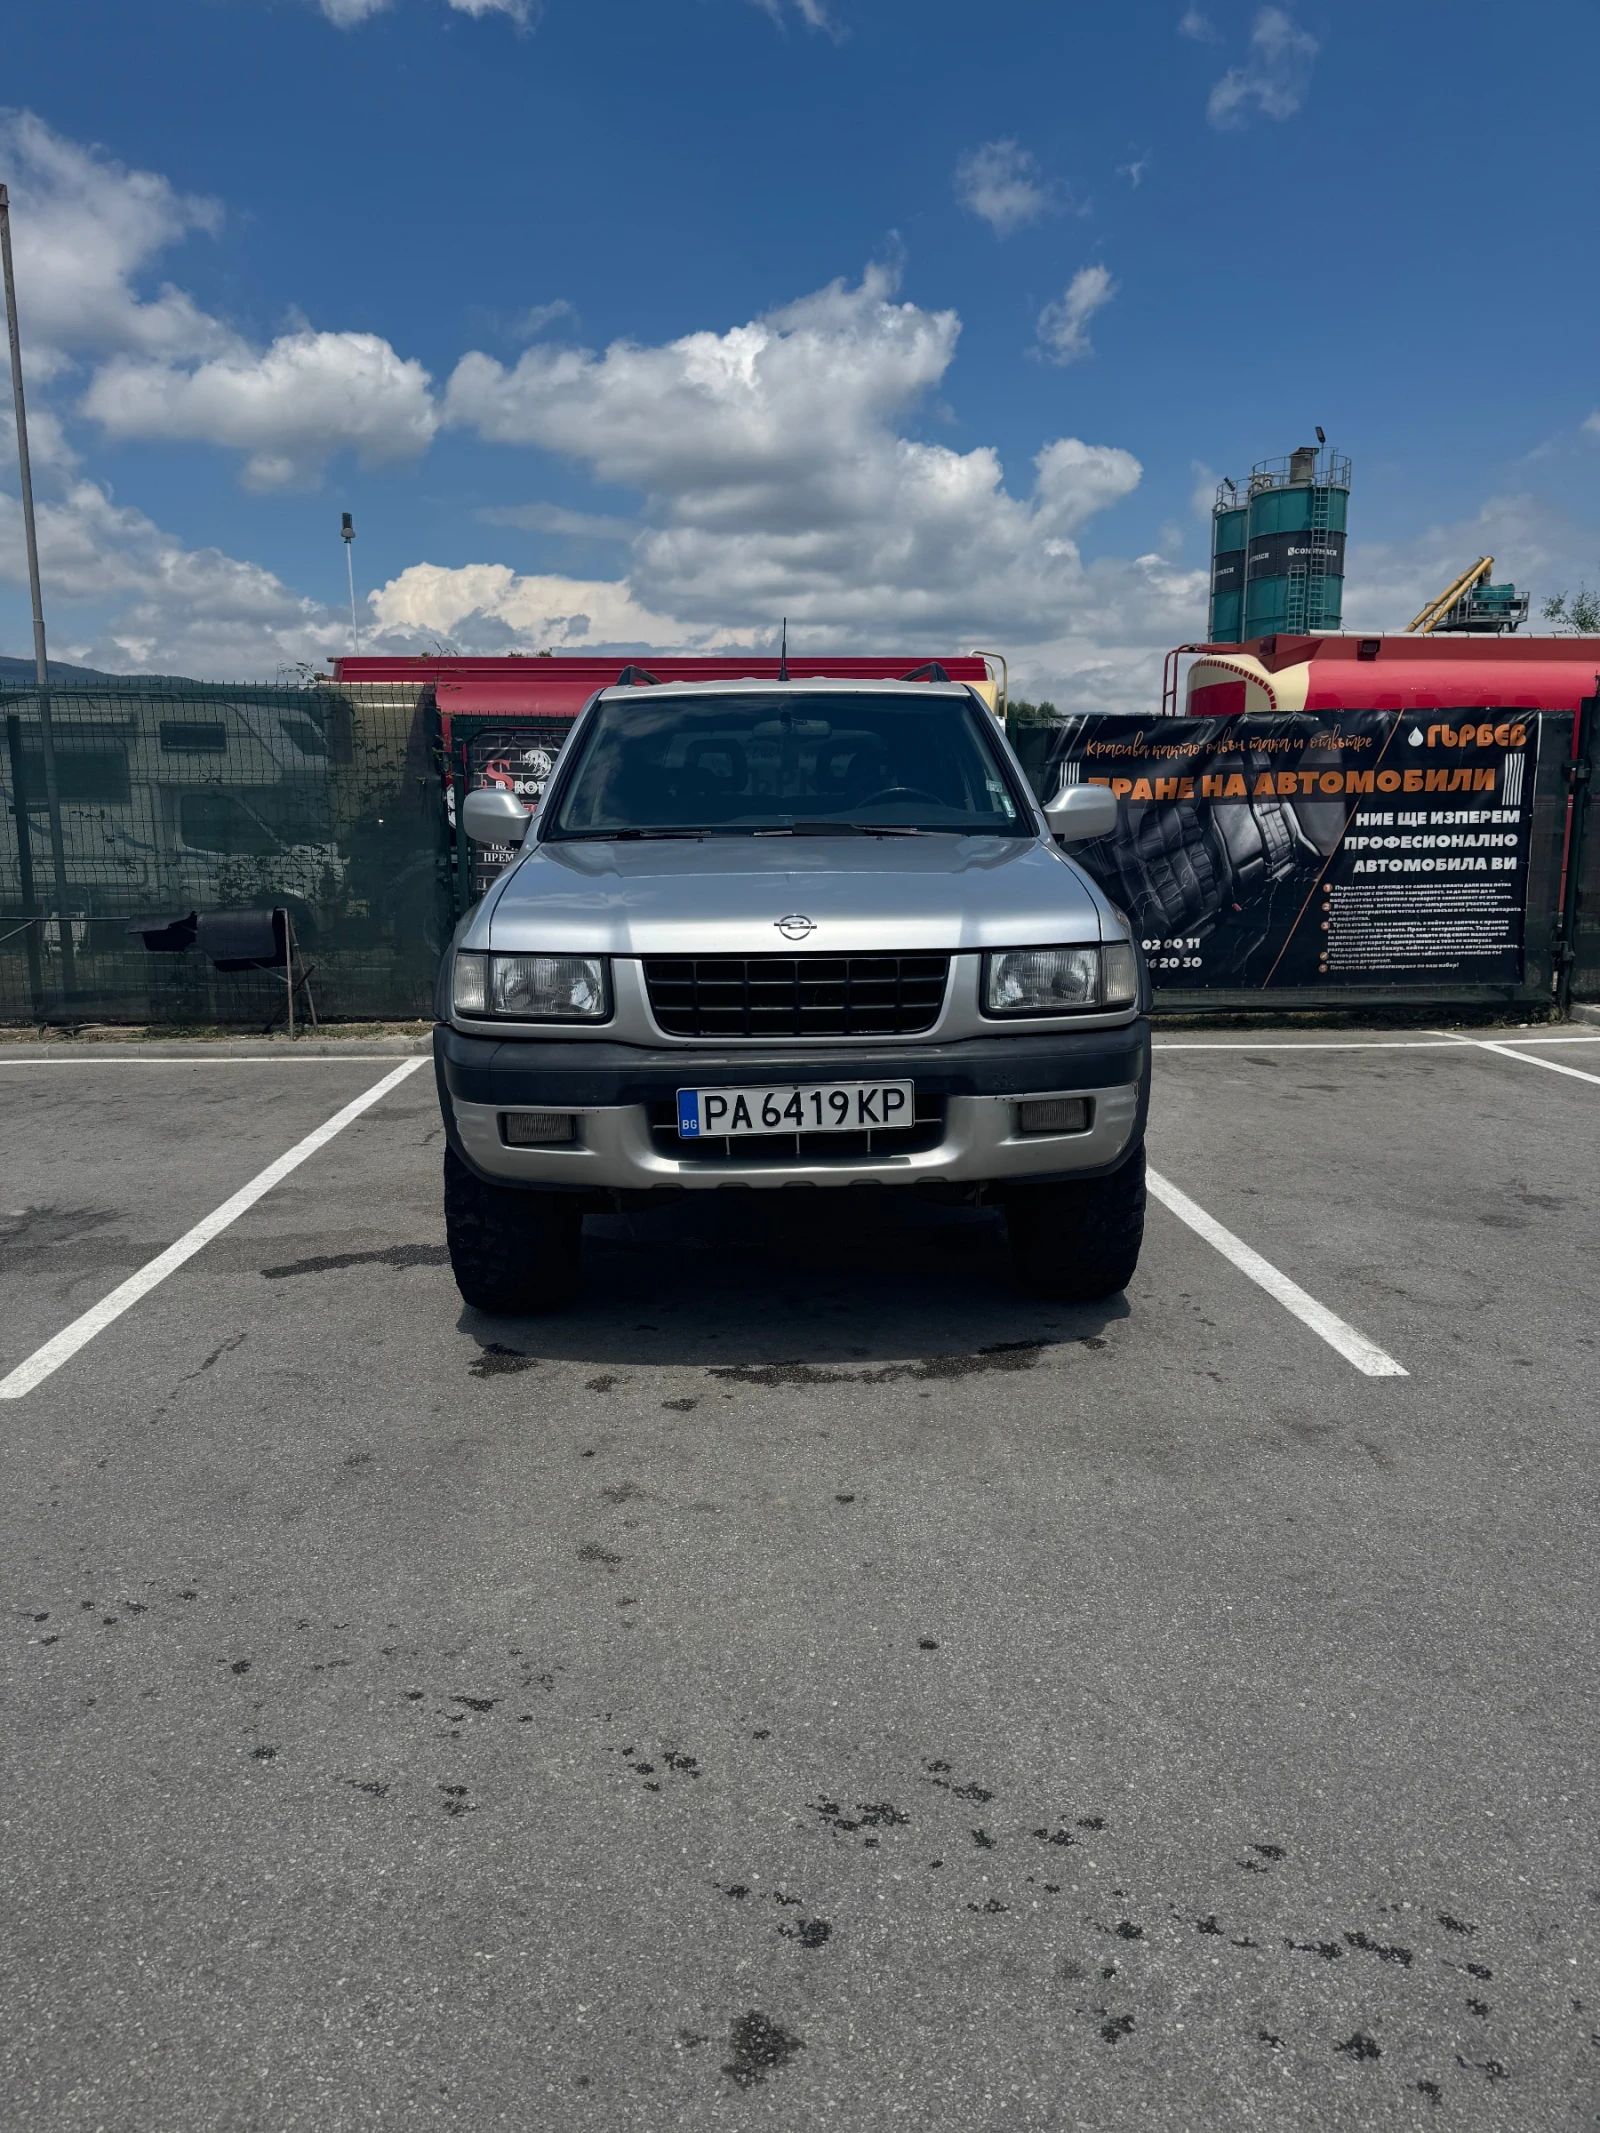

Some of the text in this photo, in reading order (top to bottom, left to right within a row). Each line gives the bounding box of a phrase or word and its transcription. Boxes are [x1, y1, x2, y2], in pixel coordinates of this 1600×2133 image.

[1086, 730, 1150, 758] Красива
[1152, 742, 1202, 760] както
[1248, 736, 1290, 754] така
[1294, 740, 1304, 749] и
[1310, 724, 1372, 752] отвътре
[1202, 773, 1247, 798] НА
[1252, 768, 1495, 795] АВТОМОБИЛИ
[1356, 810, 1521, 827] НИЕ ЩЕ ИЗПЕРЕМ
[1344, 834, 1518, 850] ПРОФЕСИОНАЛНО
[484, 852, 516, 862] ПРЕМ
[1353, 857, 1517, 873] АВТОМОБИЛА ВИ
[1142, 938, 1201, 950] 02 00 11
[1160, 957, 1180, 968] 20
[1182, 957, 1202, 968] 30
[682, 1120, 698, 1129] BG
